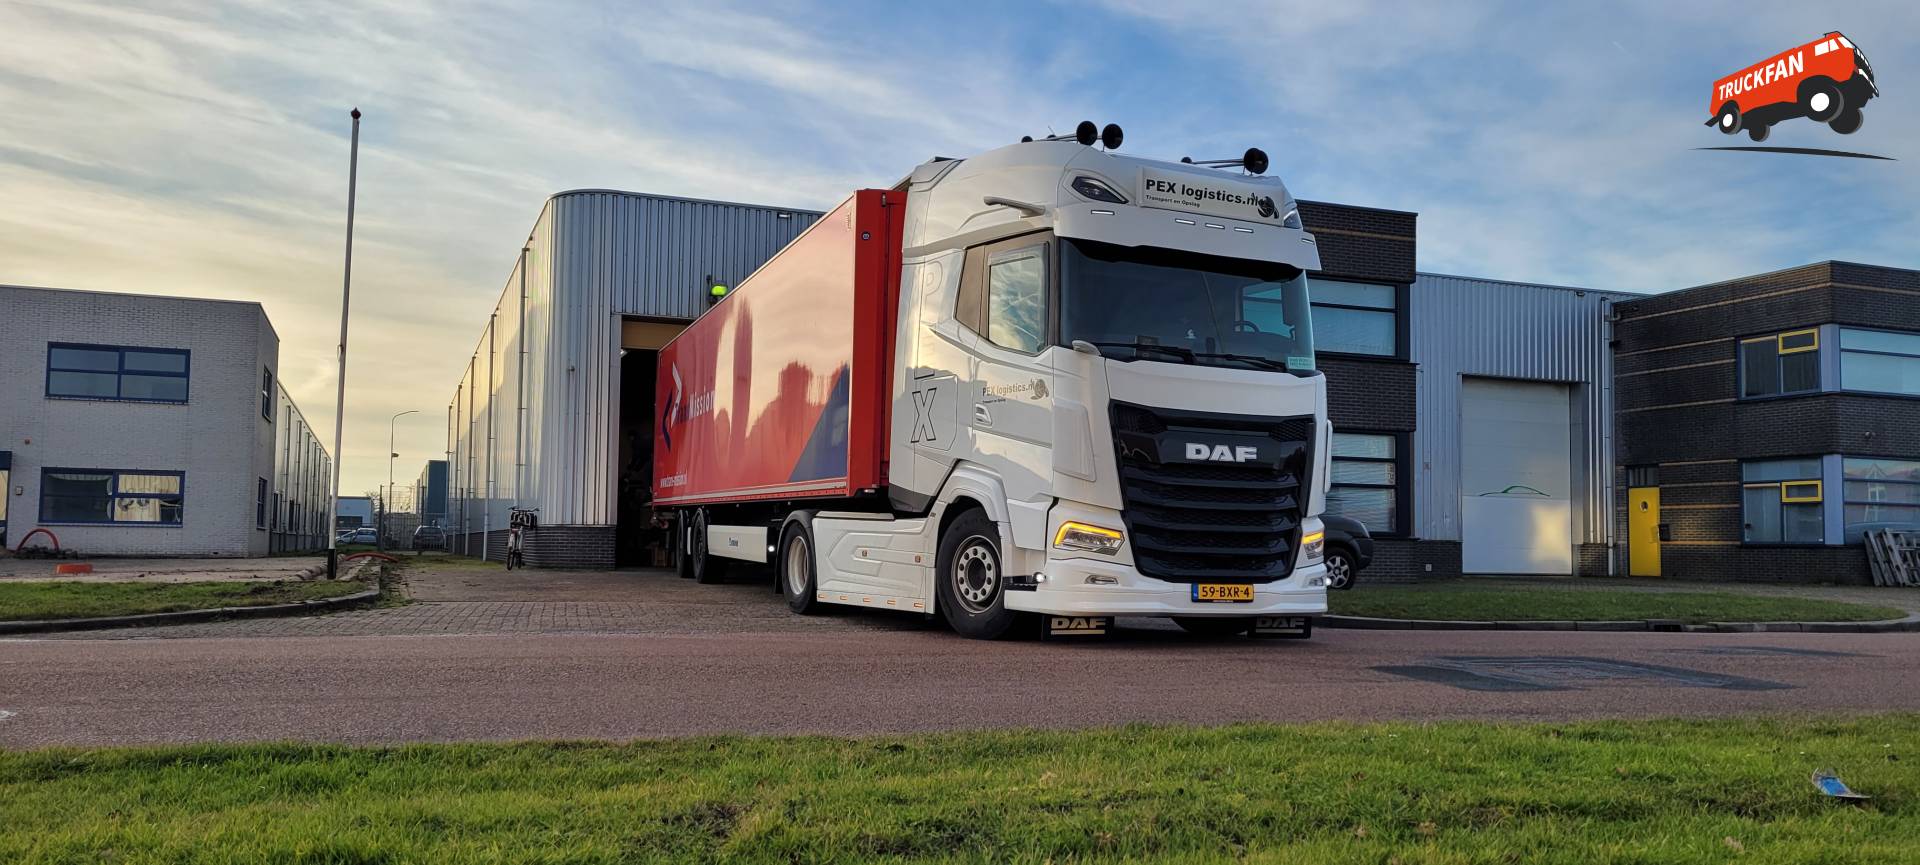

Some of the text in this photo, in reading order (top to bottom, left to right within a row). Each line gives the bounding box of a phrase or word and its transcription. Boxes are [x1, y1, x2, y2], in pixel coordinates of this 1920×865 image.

[1146, 178, 1259, 207] PEX logistics.nl
[982, 386, 995, 397] PEX
[1185, 442, 1257, 463] DAF
[1202, 586, 1250, 598] 59-BXR-4
[1050, 617, 1106, 630] DAF
[1255, 616, 1304, 628] DAF
